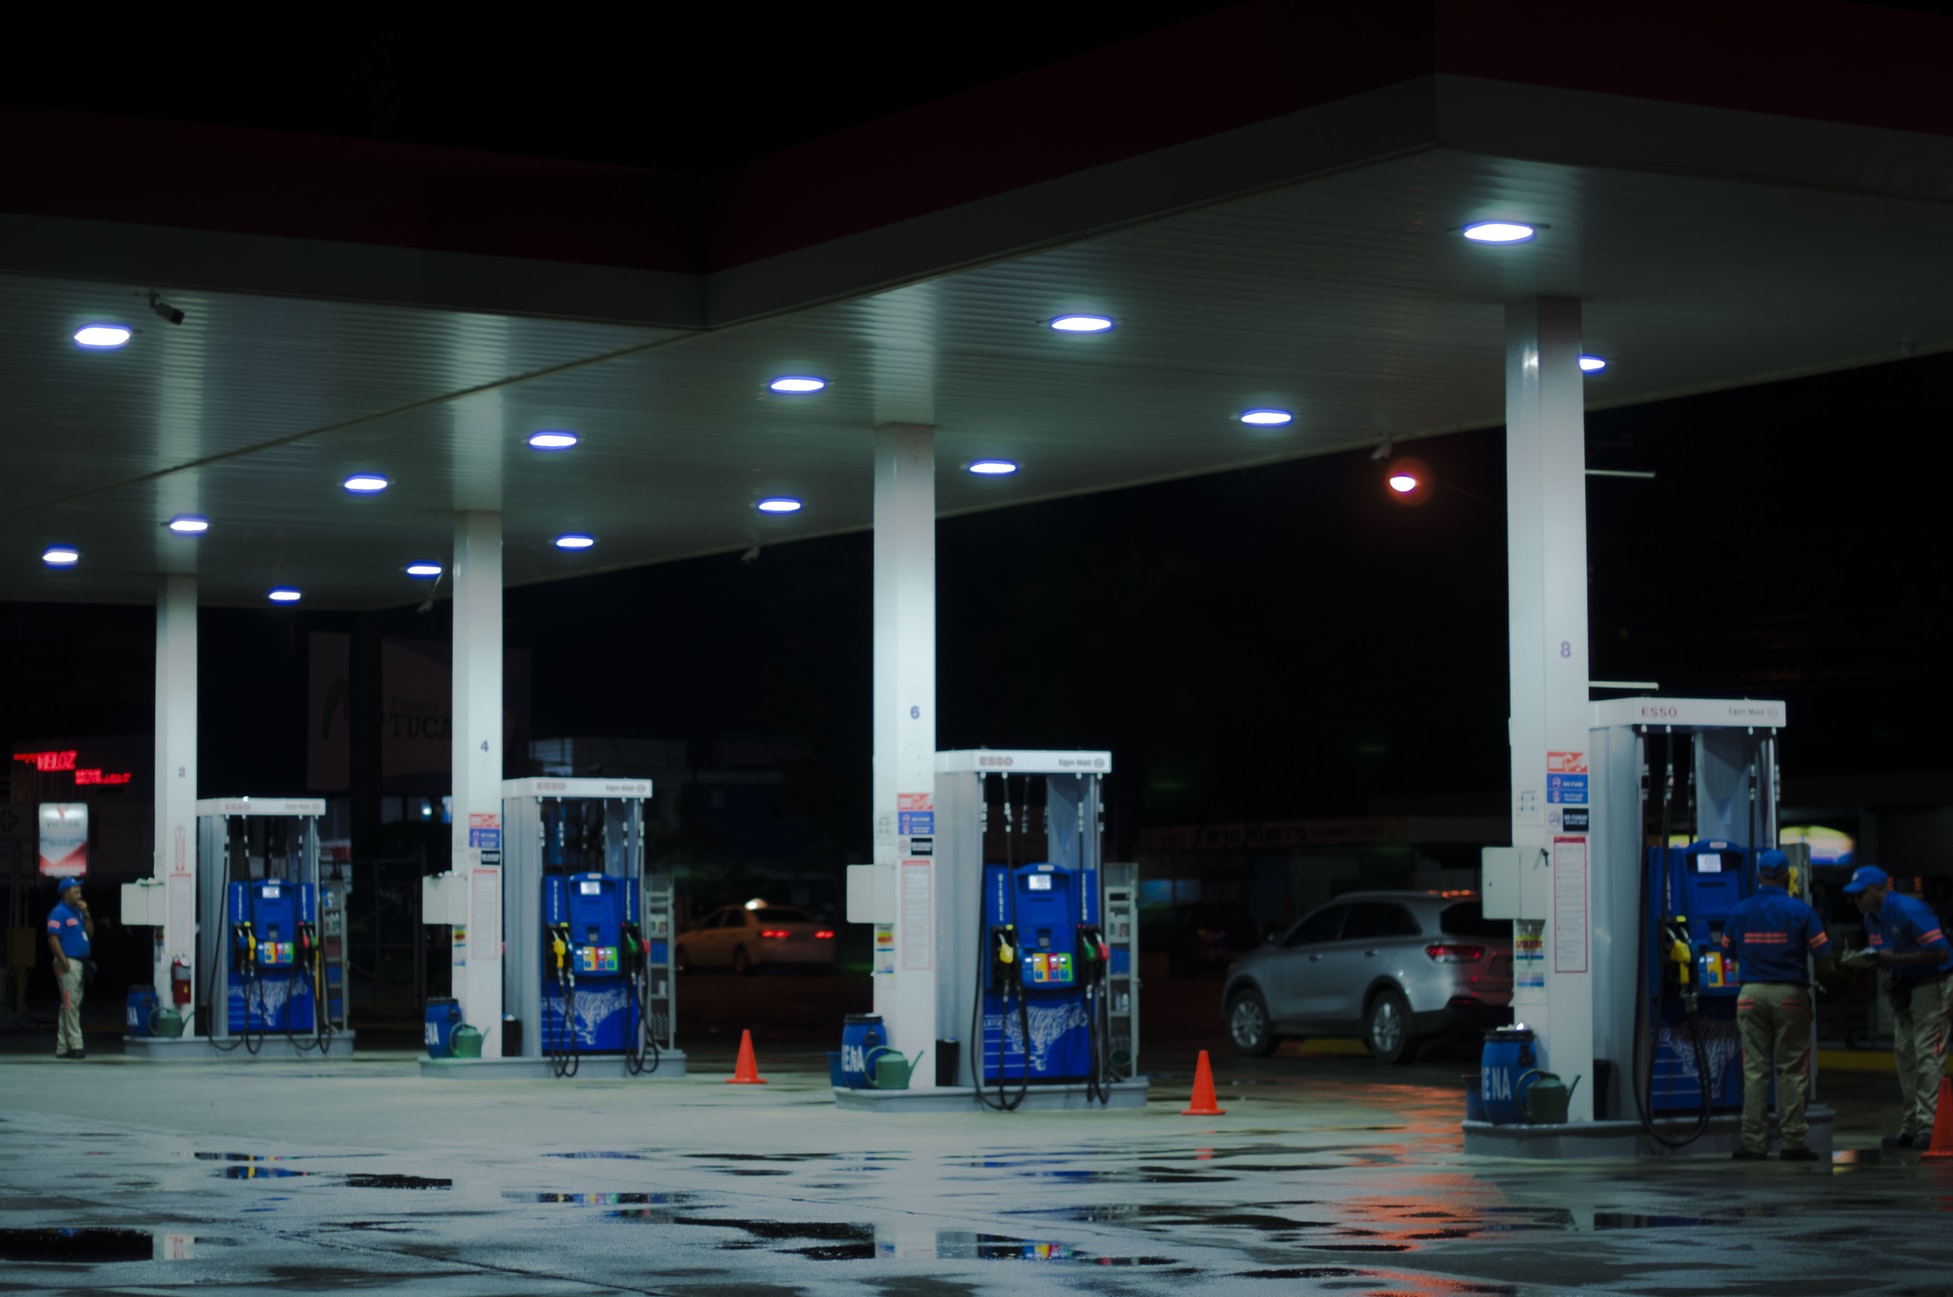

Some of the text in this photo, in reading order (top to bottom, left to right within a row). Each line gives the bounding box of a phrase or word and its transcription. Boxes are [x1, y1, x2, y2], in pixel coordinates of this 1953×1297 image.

[1560, 642, 1571, 658] 8
[911, 706, 920, 719] 6
[1642, 707, 1677, 717] ESSO
[480, 741, 489, 752] 4
[37, 751, 77, 771] VELOZ
[979, 756, 1013, 767] ESSO
[1482, 1066, 1512, 1101] ENA
